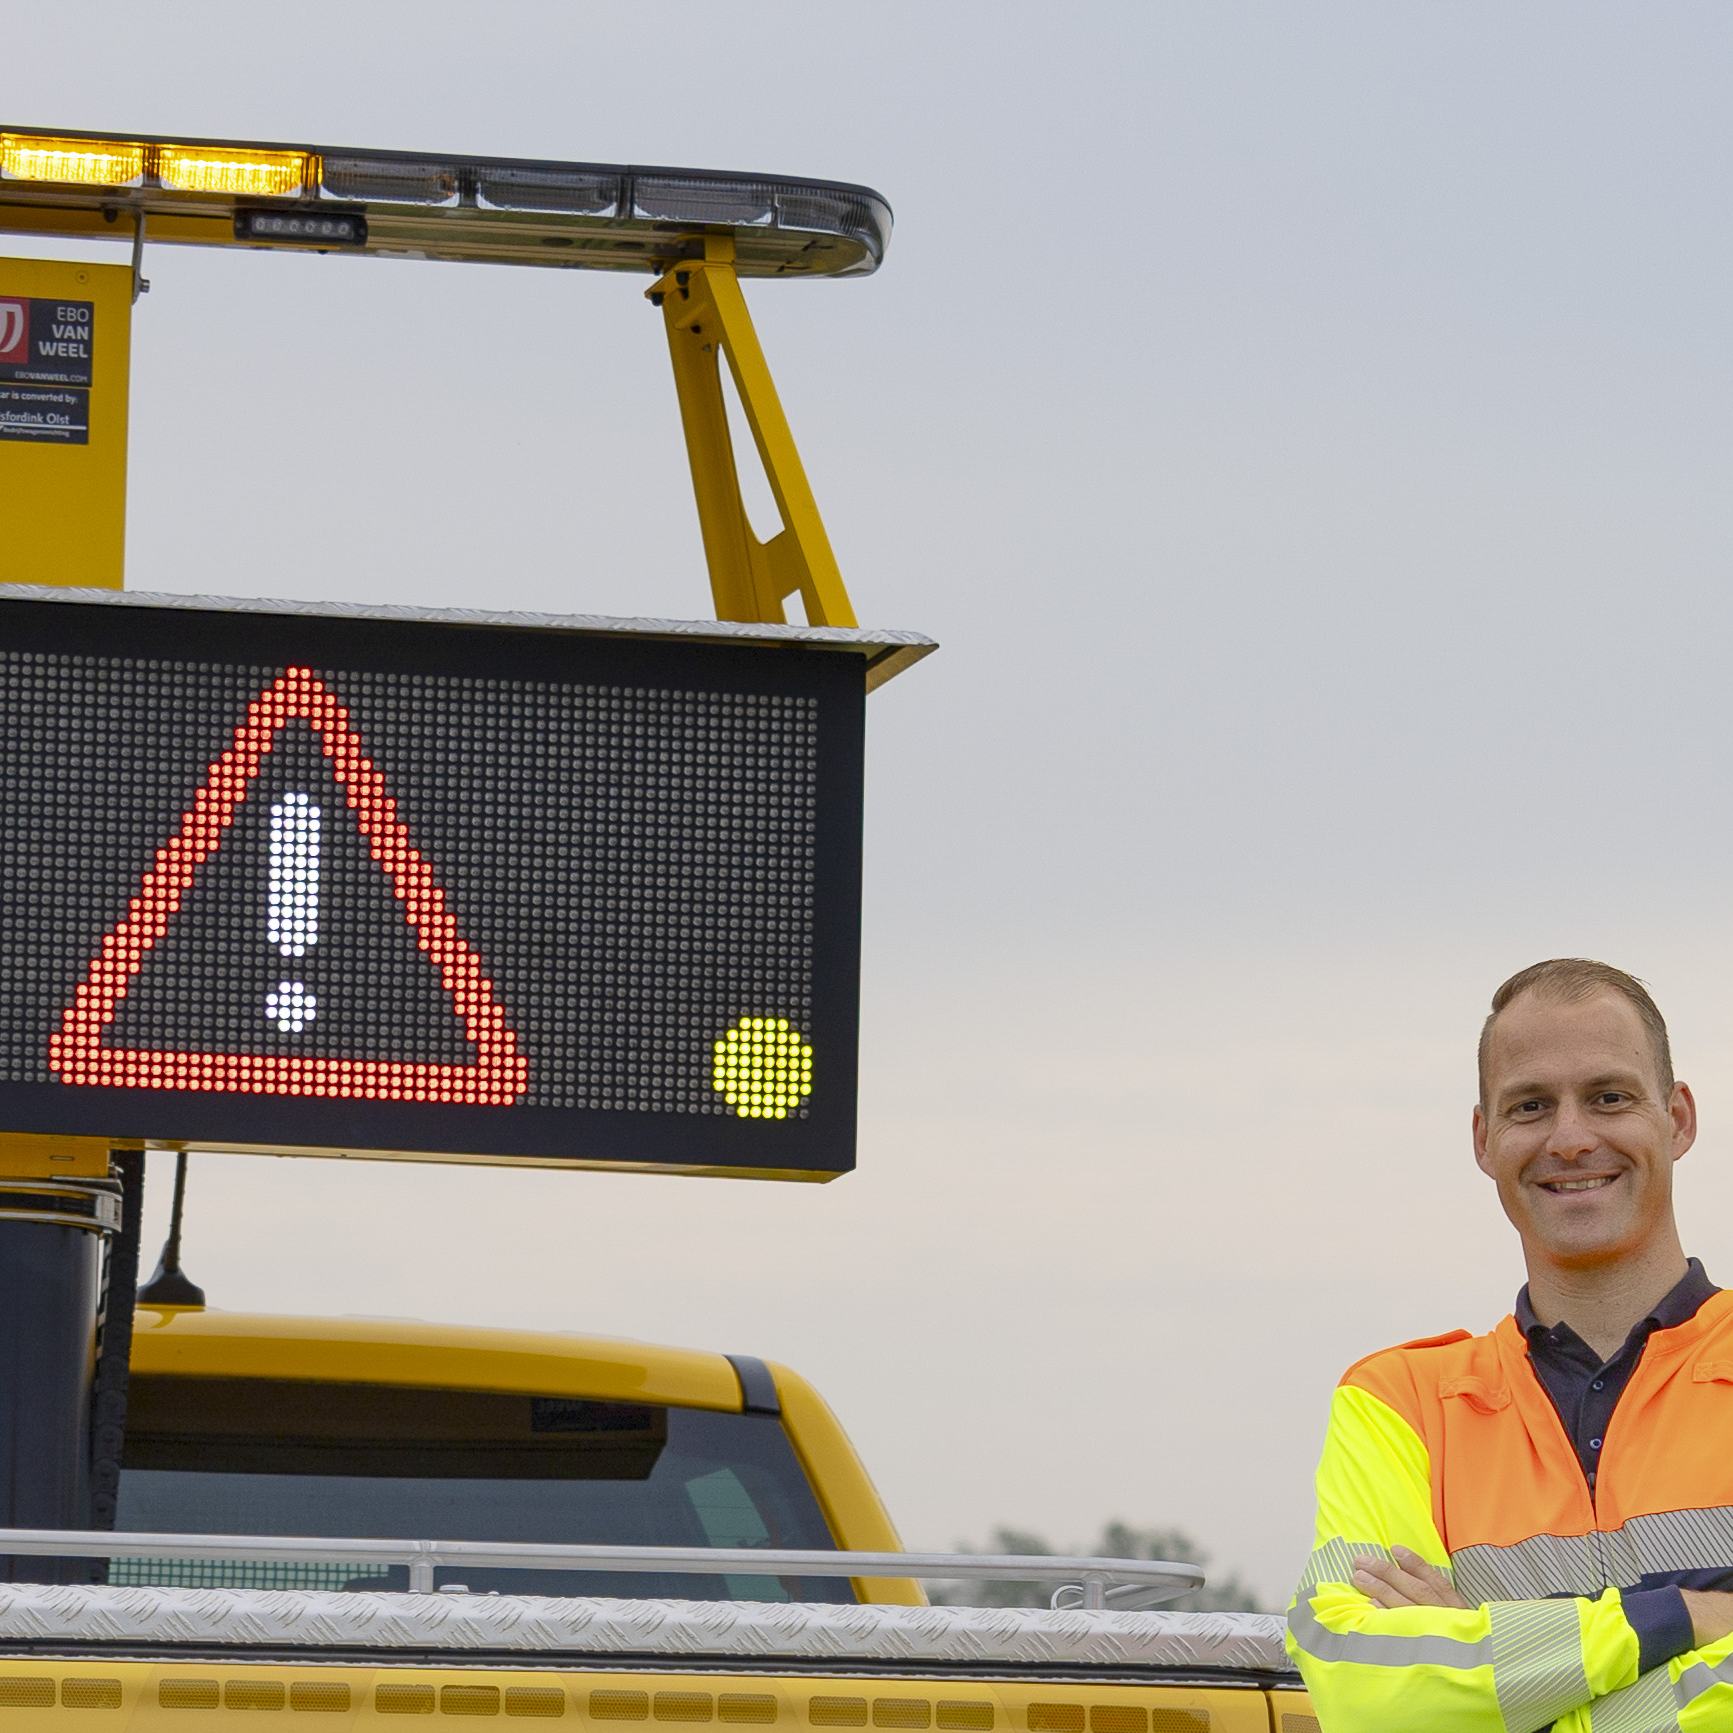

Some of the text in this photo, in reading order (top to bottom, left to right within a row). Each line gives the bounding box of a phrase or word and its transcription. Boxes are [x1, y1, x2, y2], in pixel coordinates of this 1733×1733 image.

[57, 306, 89, 322] EBO
[52, 324, 89, 340] VAN
[38, 341, 89, 358] WEEL
[15, 371, 88, 383] EBOVANWEEL.COM
[11, 391, 19, 400] is
[21, 392, 63, 403] converted
[46, 413, 70, 425] Olst
